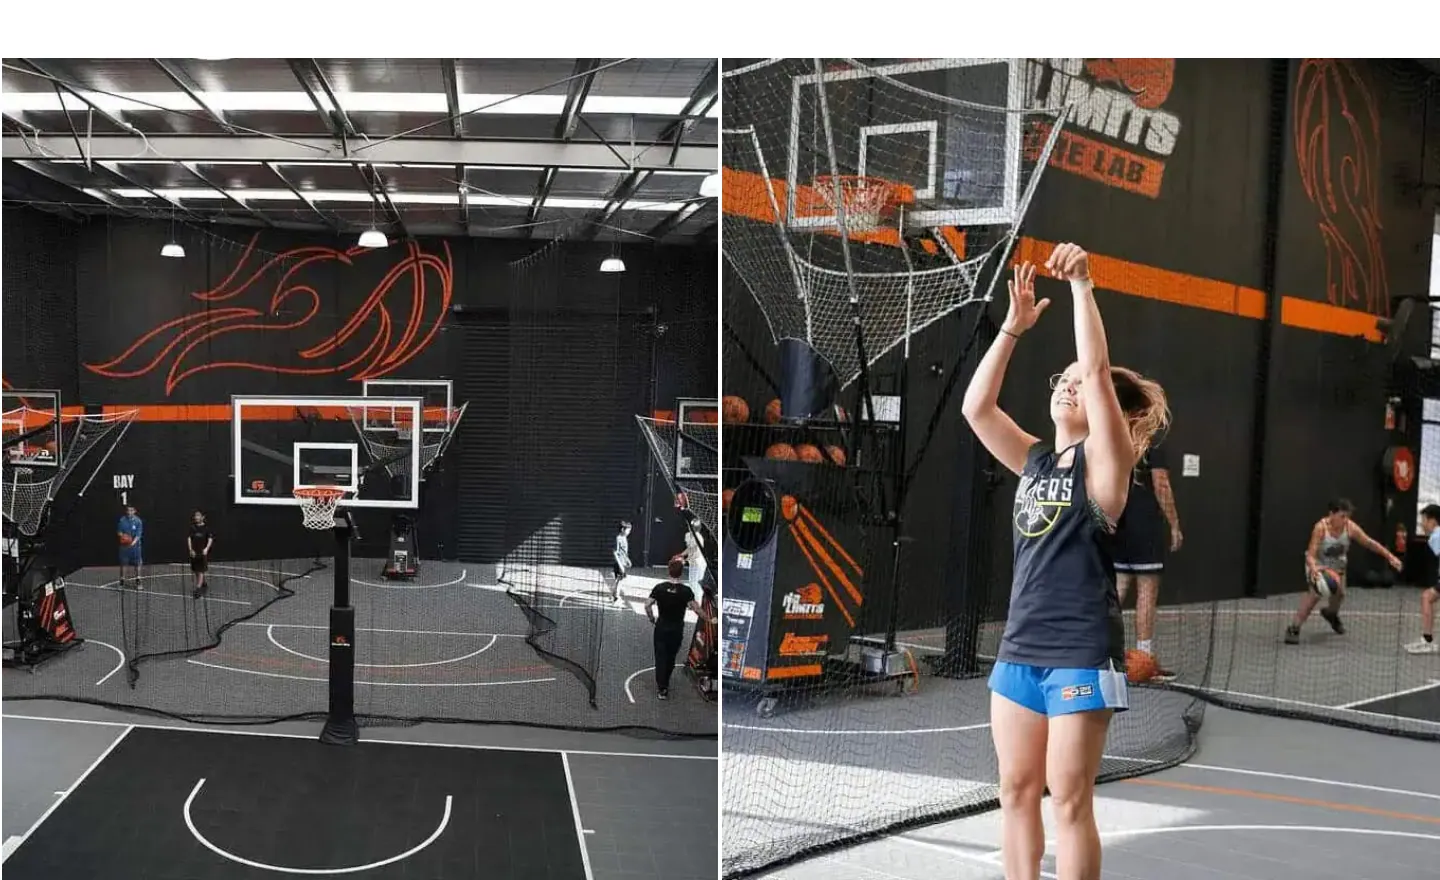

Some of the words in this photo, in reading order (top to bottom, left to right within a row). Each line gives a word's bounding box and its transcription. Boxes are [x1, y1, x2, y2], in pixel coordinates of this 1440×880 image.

[1092, 149, 1146, 184] LAB
[113, 474, 135, 489] BAY
[120, 491, 128, 506] 1
